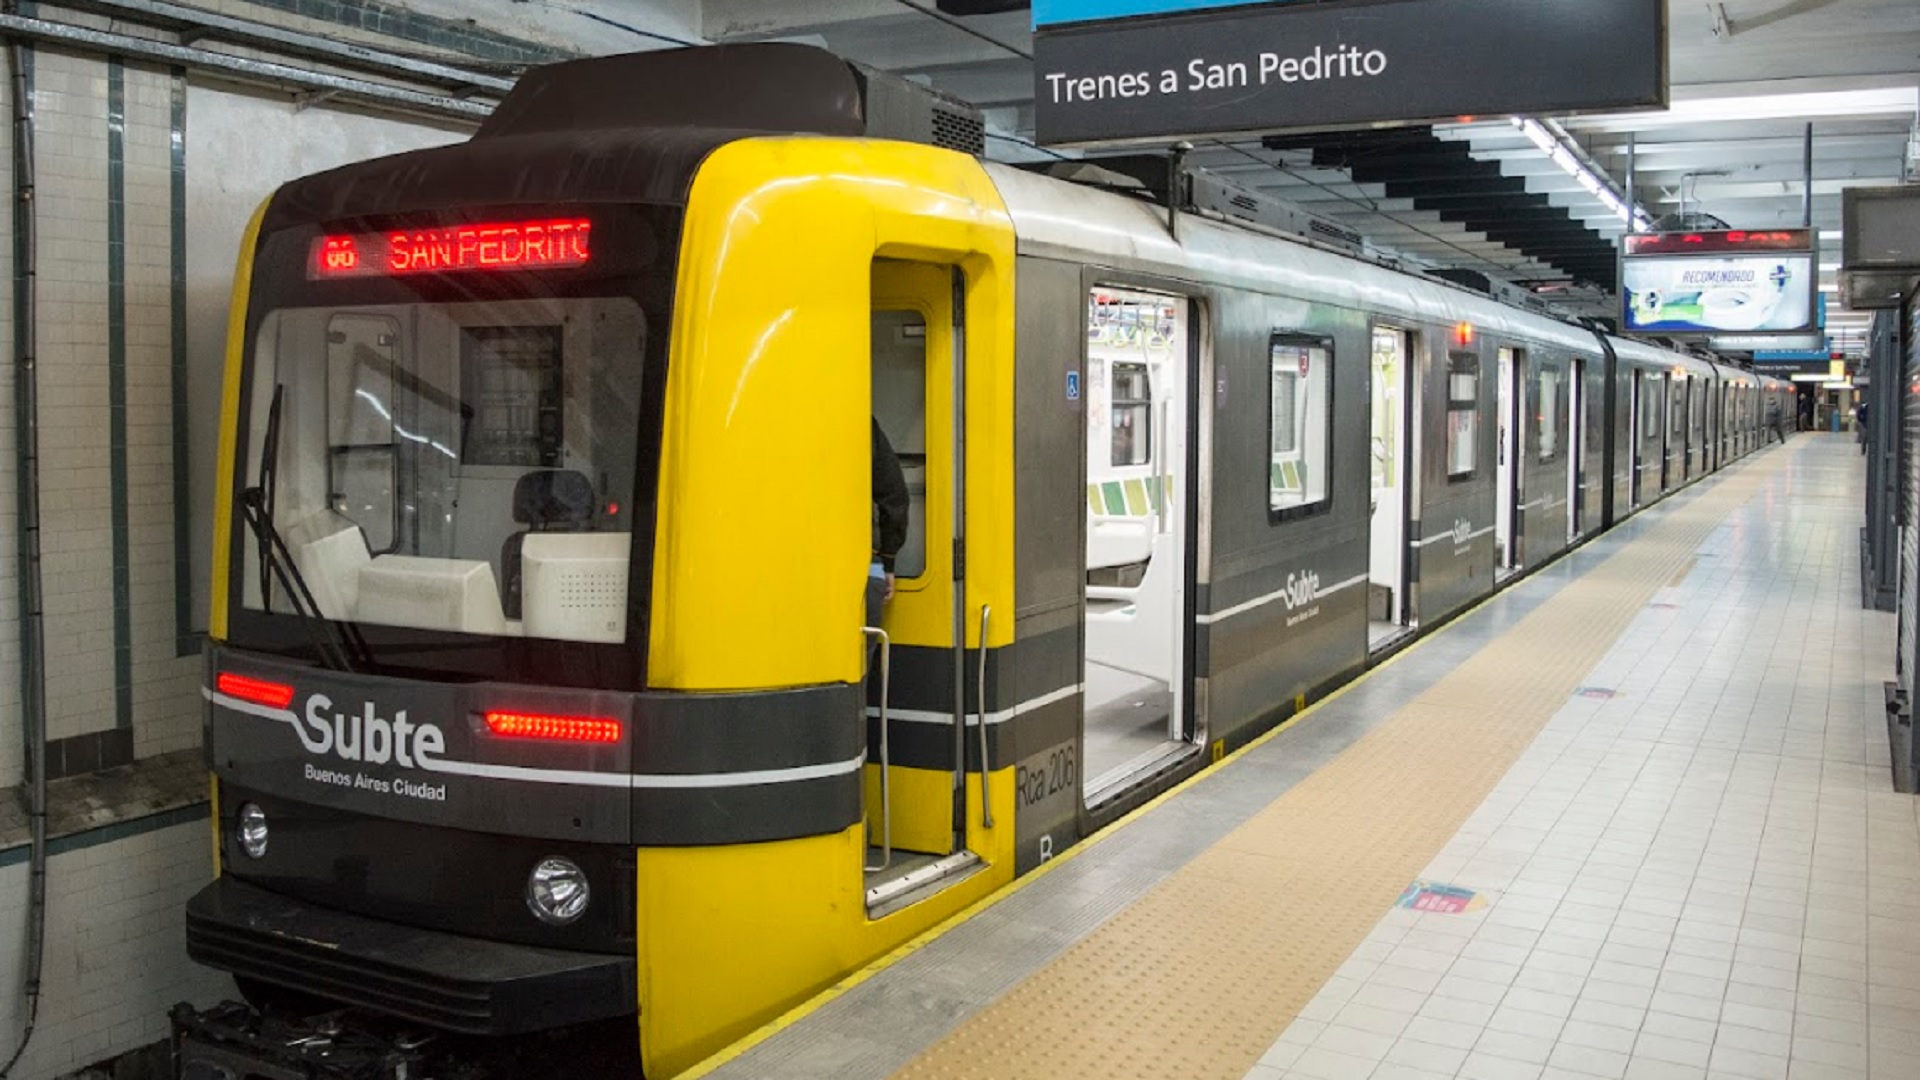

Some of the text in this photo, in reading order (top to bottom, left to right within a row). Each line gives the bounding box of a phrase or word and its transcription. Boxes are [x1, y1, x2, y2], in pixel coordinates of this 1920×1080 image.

[1045, 43, 1387, 103] Trenes a San Pedrito
[390, 232, 450, 269] SAN
[1681, 269, 1756, 284] RECOMENDADO
[1286, 569, 1320, 610] Subte
[302, 692, 446, 771] Subte
[304, 763, 446, 801] Buenos Aires Ciudad
[1017, 744, 1074, 806] Rca 206
